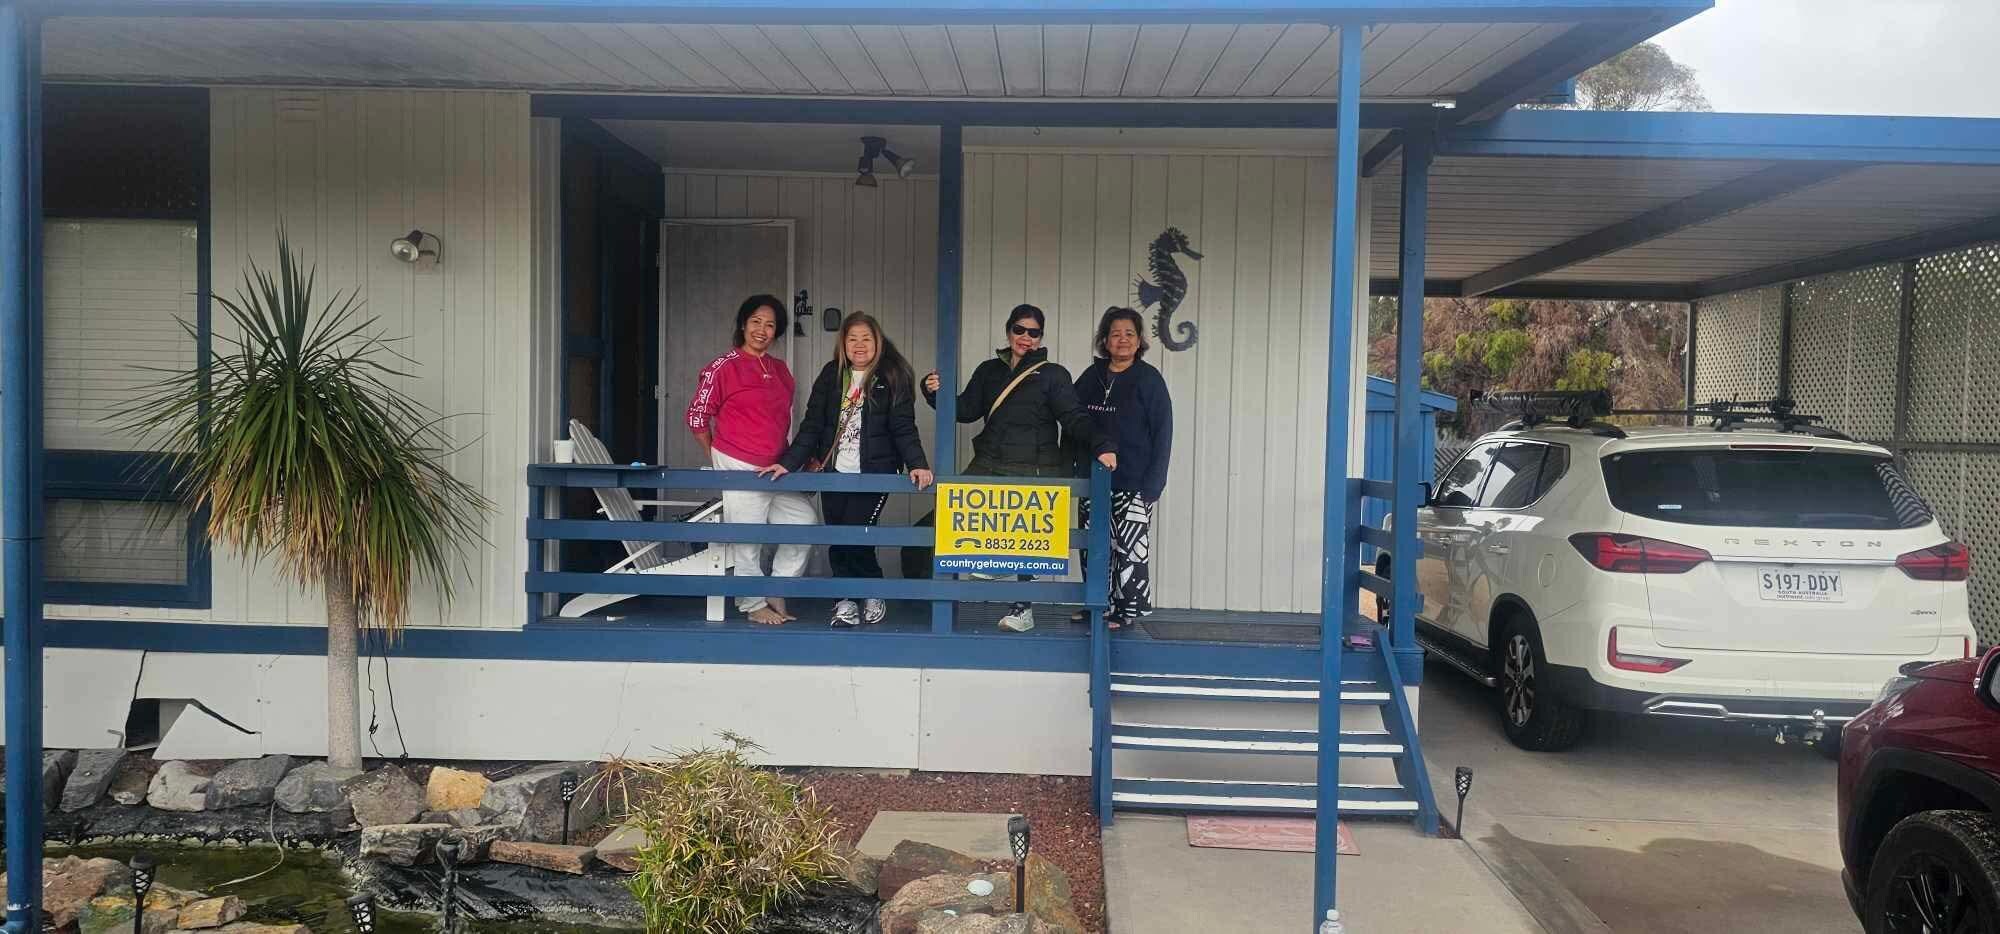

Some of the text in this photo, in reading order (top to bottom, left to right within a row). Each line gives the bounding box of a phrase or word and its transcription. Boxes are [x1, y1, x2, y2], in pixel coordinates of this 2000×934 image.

[948, 489, 1059, 511] HOLIDAY
[953, 512, 1054, 534] RENTALS
[985, 538, 1050, 551] 8832 2623
[1724, 537, 1882, 548] REXTON
[939, 559, 1065, 571] countrygetaways.com.au
